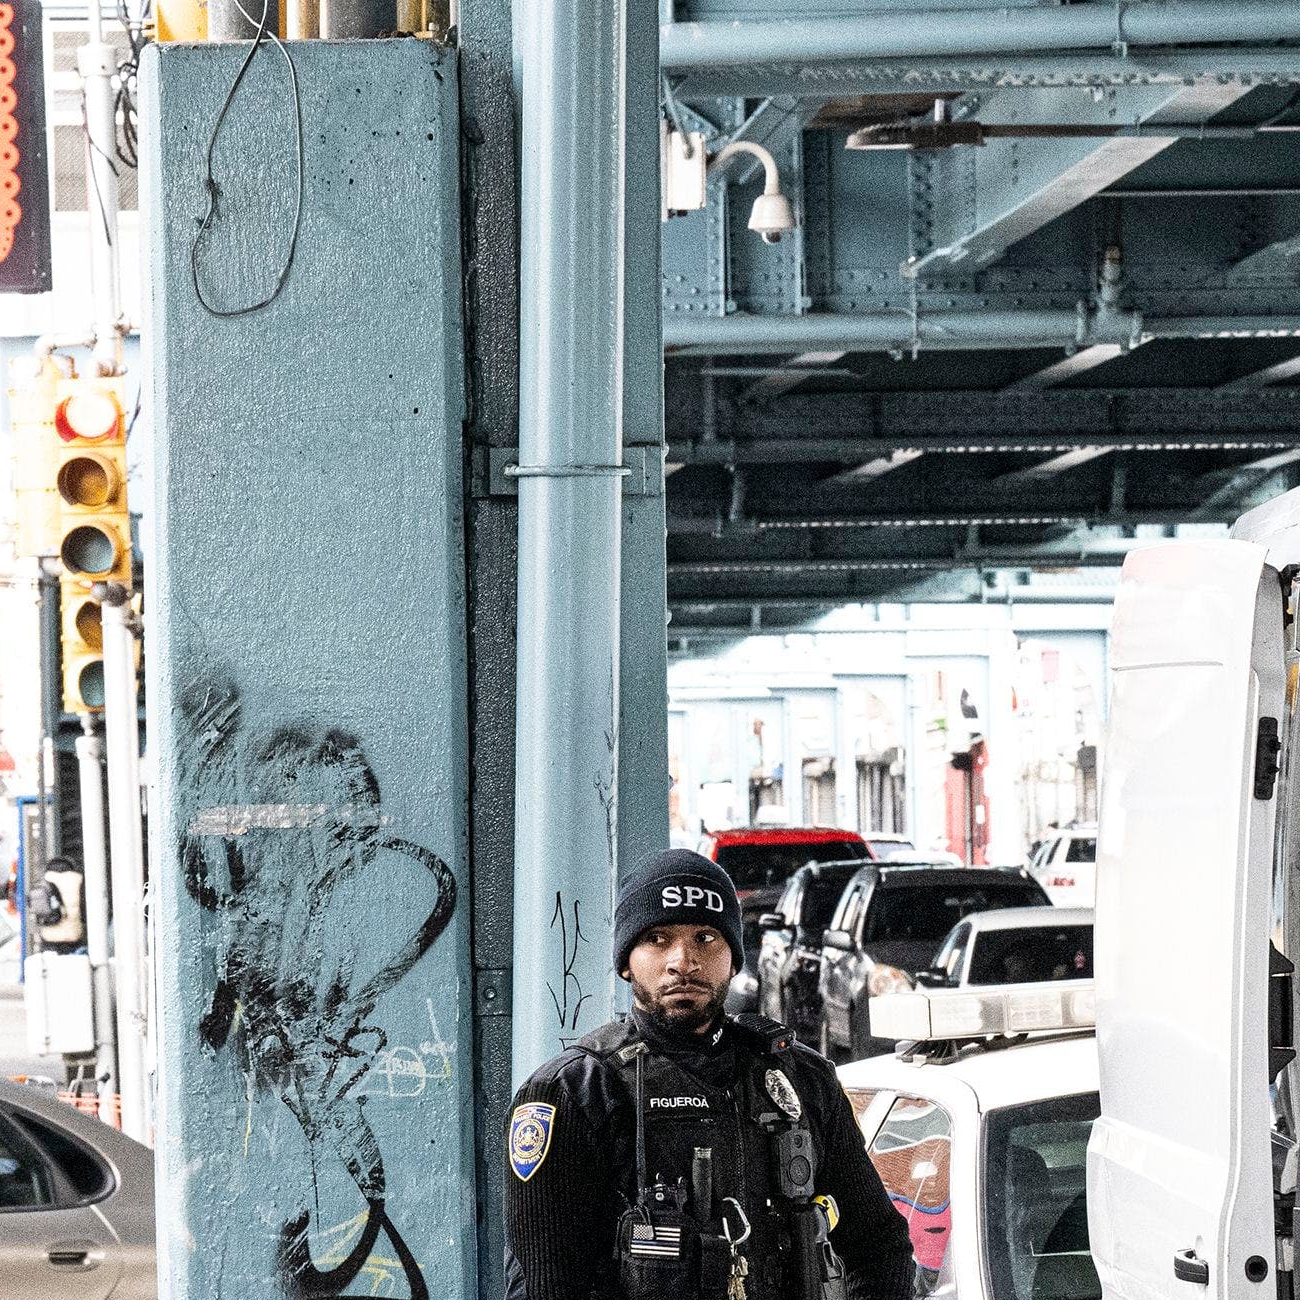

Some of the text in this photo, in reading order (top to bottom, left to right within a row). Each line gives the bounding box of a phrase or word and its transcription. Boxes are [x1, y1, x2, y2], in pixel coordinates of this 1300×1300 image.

[661, 885, 724, 913] SPD
[650, 1097, 710, 1108] FIGUEROA
[533, 1113, 551, 1122] POLICE
